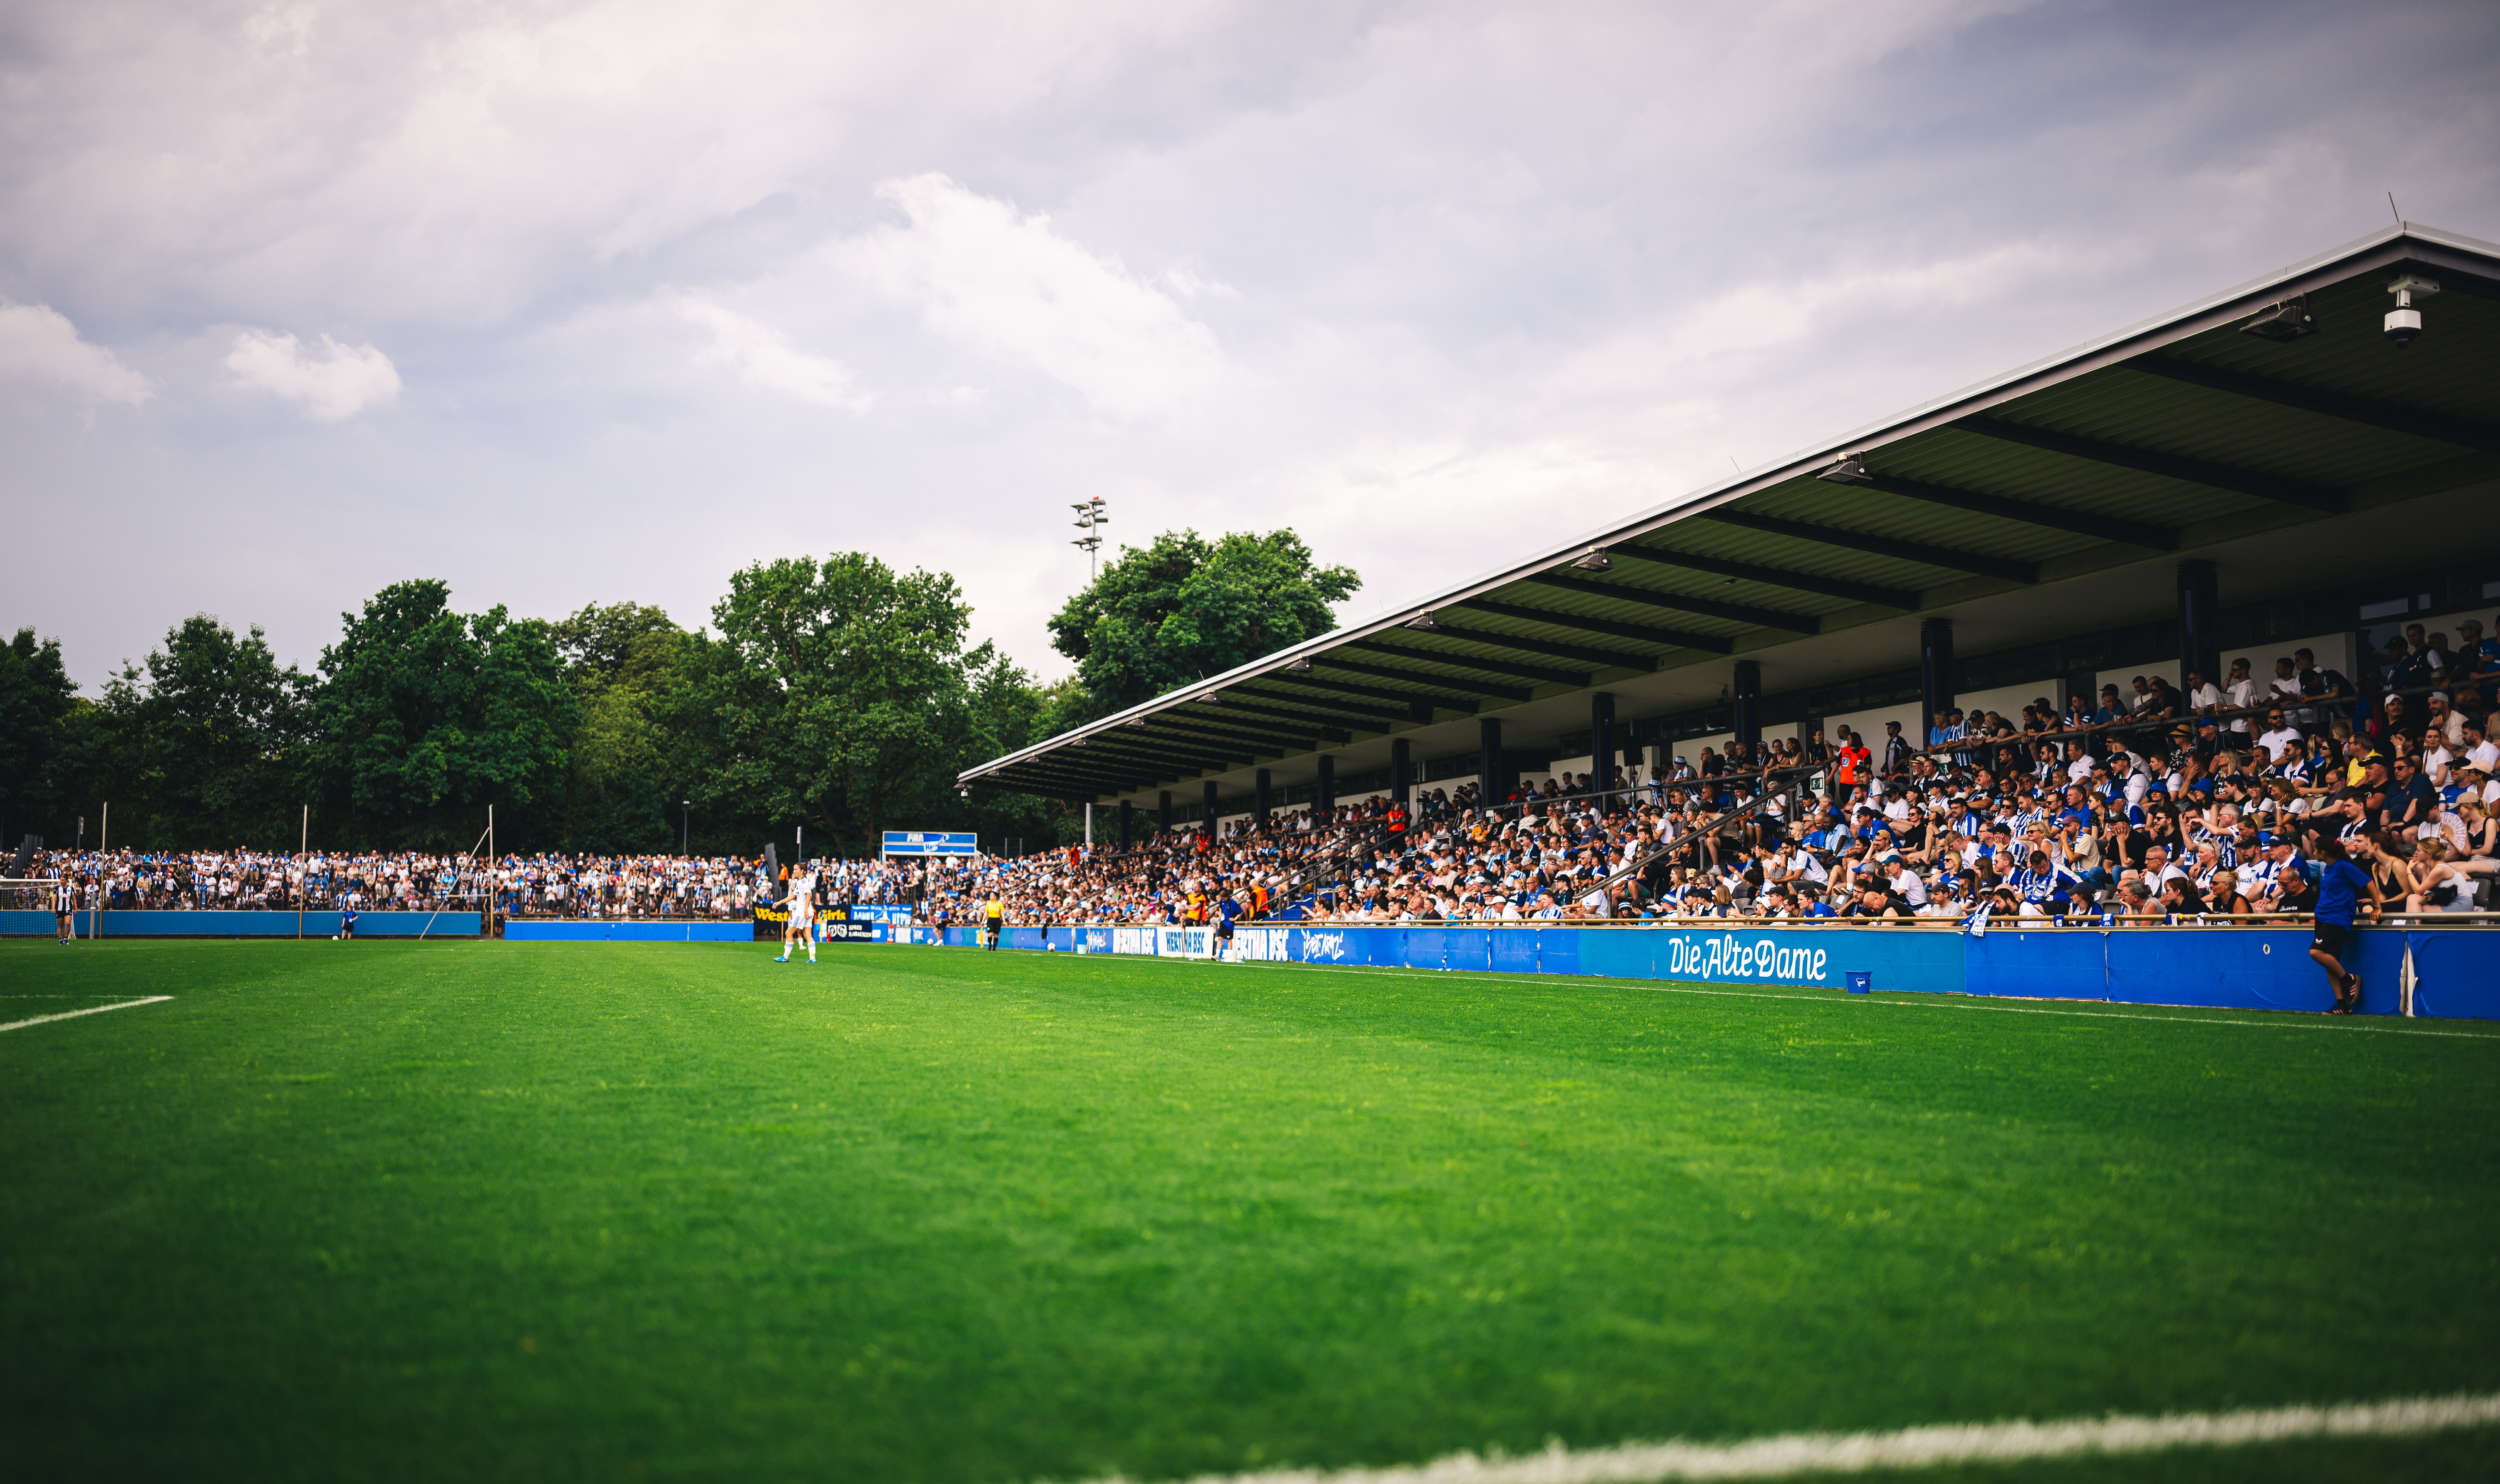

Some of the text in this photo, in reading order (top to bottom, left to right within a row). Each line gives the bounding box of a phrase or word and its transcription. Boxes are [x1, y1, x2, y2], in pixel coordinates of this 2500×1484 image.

[754, 906, 790, 922] West
[818, 908, 846, 921] Girls
[1141, 928, 1155, 955] BSC
[1166, 931, 1205, 954] HERTHA BSC
[1269, 928, 1289, 961] BSC
[1669, 933, 1826, 981] Die Alte Dame
